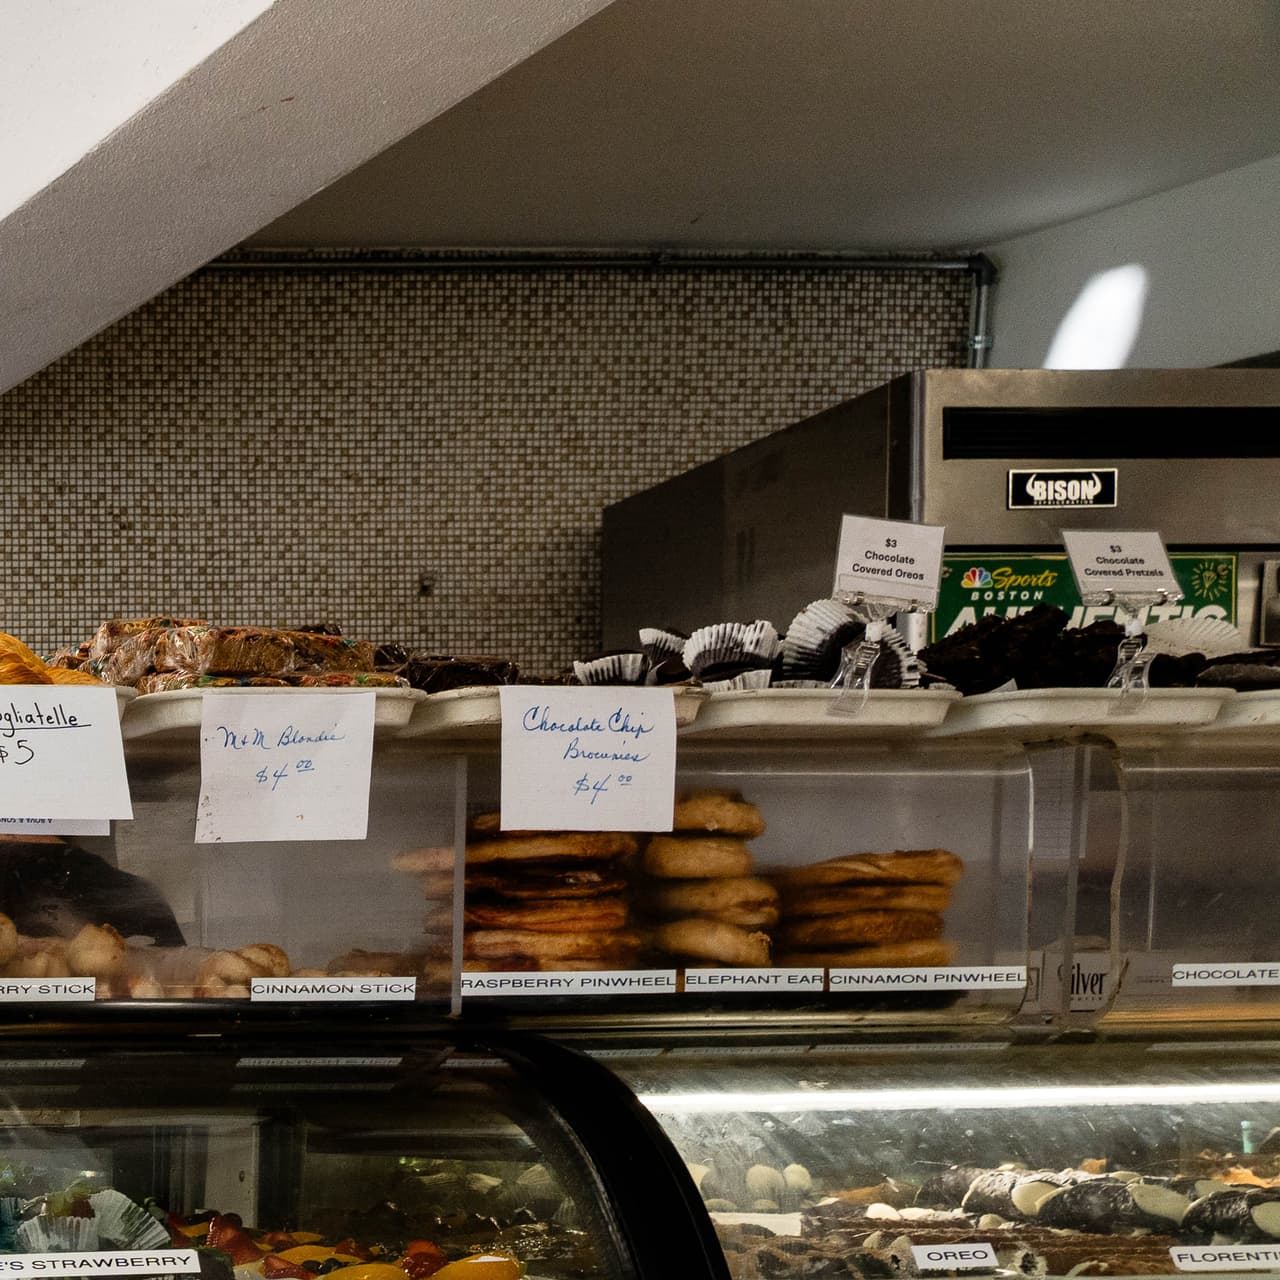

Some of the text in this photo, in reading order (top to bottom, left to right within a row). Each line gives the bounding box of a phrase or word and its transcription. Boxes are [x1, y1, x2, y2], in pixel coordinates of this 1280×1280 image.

[1034, 480, 1093, 501] BISON
[885, 539, 897, 548] $3
[1110, 545, 1122, 553] $3
[865, 551, 915, 565] Chocolate
[1095, 556, 1145, 565] Chocolate
[852, 563, 924, 581] Covered Oreos
[1084, 568, 1164, 577] Covered Pretzels
[992, 567, 1058, 590] Sports
[971, 591, 1044, 601] BOSTON
[522, 706, 654, 737] Chocolate Chip
[685, 974, 823, 985] ELEPHANT EAR
[830, 972, 1025, 985] CINNAMON PINWHEEL
[1173, 969, 1278, 980] CHOCOLATE
[251, 983, 415, 994] CINNAMON STICK
[461, 976, 676, 989] RASPBERRY PINWHEEL
[38, 984, 95, 995] STICK
[926, 1250, 989, 1262] OREO
[1176, 1251, 1279, 1263] FLORENTI
[31, 1256, 191, 1270] STRAWBERRY
